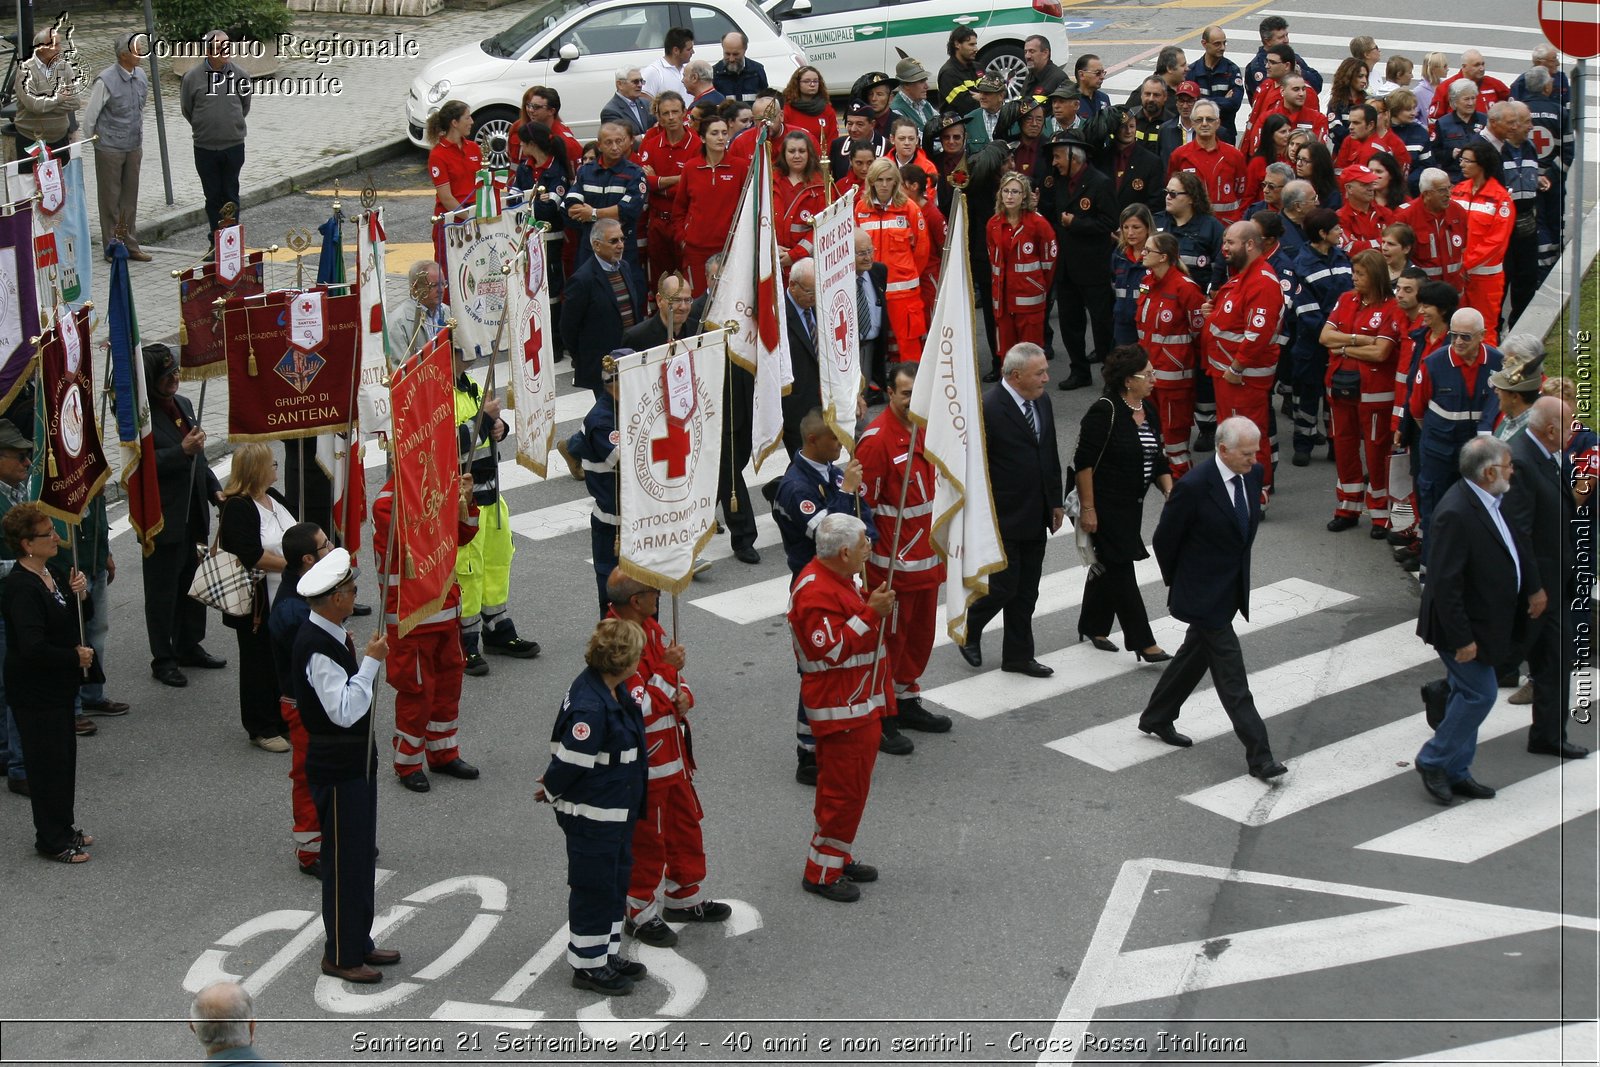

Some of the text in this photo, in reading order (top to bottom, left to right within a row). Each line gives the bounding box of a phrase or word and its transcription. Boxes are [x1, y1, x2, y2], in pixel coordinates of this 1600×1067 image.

[815, 29, 853, 43] MUNICIPALE
[810, 52, 837, 62] SANTENA
[838, 217, 853, 240] ROSS
[825, 241, 850, 272] ITALIANA
[275, 393, 329, 407] GRUPPO DI
[396, 364, 452, 440] BANDA MUSCALE
[627, 392, 652, 446] CROCE
[694, 376, 716, 421] ALIANA
[267, 407, 339, 425] SANTENA
[432, 401, 452, 427] SERRA
[647, 412, 656, 425] DI
[636, 428, 665, 499] CONVENZIONE
[632, 497, 711, 533] OTTOCOMITO DI
